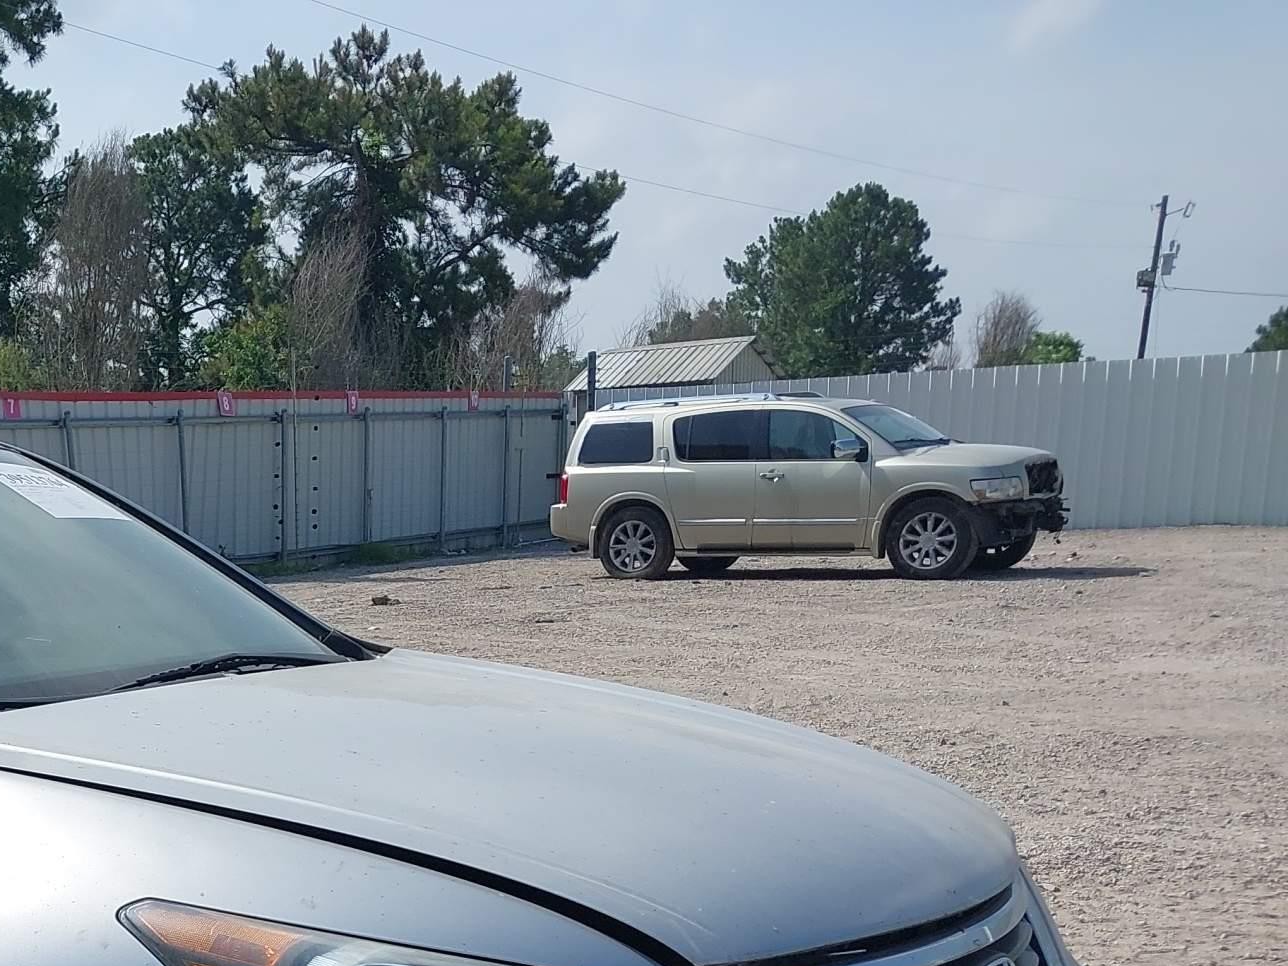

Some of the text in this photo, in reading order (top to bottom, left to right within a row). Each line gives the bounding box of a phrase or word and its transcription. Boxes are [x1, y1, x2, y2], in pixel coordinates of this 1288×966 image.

[7, 399, 15, 414] 7
[222, 396, 230, 411] 8
[350, 396, 357, 410] 9
